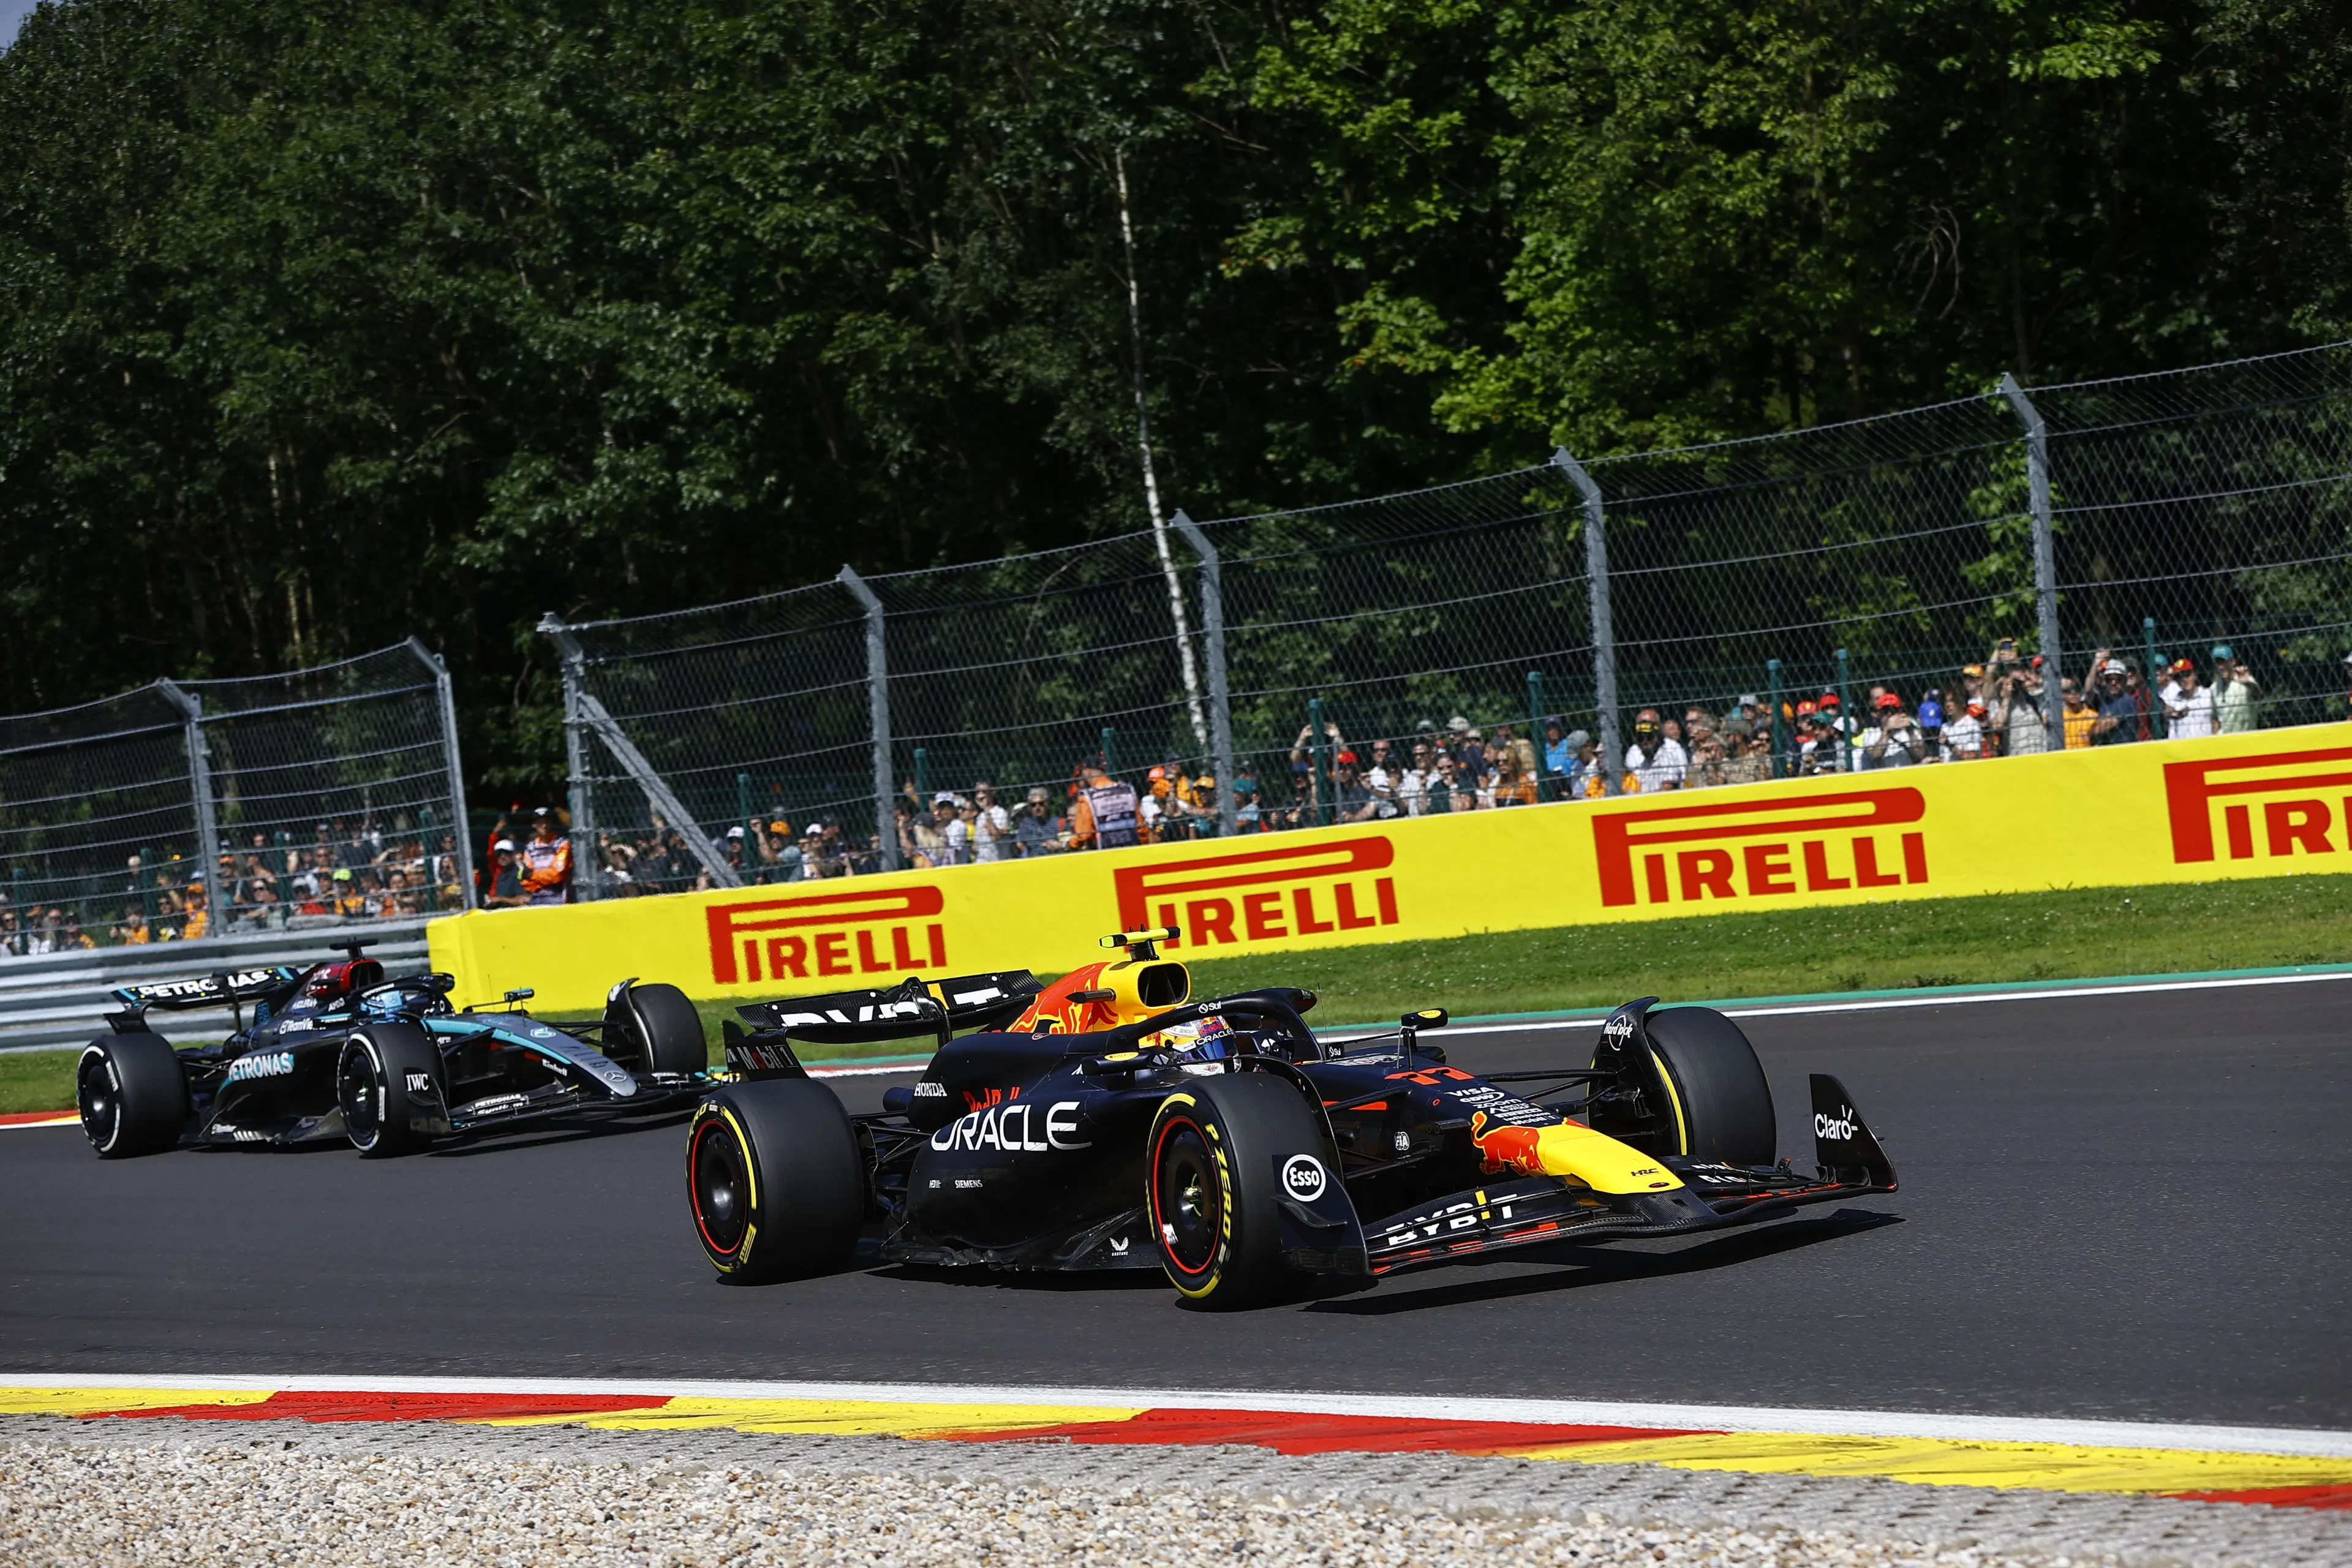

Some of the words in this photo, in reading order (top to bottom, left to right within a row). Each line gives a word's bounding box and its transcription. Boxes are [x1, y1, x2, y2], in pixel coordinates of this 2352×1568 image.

[2163, 747, 2352, 864] PIR
[1592, 787, 1928, 907] PIRELLI
[1114, 836, 1399, 953] PIRELLI
[706, 886, 946, 984] PIRELLI
[1209, 1001, 1221, 1010] Sui
[286, 1017, 326, 1032] TeamVie
[1604, 1022, 1619, 1035] Hard
[1196, 1030, 1231, 1046] ORACLE
[736, 1046, 782, 1070] Mobil
[542, 1058, 567, 1076] Einhell
[405, 1073, 429, 1091] IWC
[1384, 1067, 1475, 1085] 11
[914, 1082, 948, 1096] HONDA
[992, 1087, 1020, 1106] Bll
[1444, 1087, 1496, 1096] VISA
[475, 1093, 521, 1107] PETRONAS
[1460, 1094, 1495, 1102] CDW
[1472, 1099, 1523, 1109] zoom
[1494, 1108, 1543, 1118] PIRELLI
[1510, 1115, 1547, 1125] Mobil
[930, 1101, 1092, 1151] ORACLE
[1814, 1112, 1852, 1140] Claro
[1289, 1167, 1320, 1186] Esso
[1631, 1168, 1659, 1177] HRC
[955, 1180, 983, 1188] SIEMENS
[1205, 1123, 1219, 1141] P
[1214, 1147, 1232, 1240] ZERO
